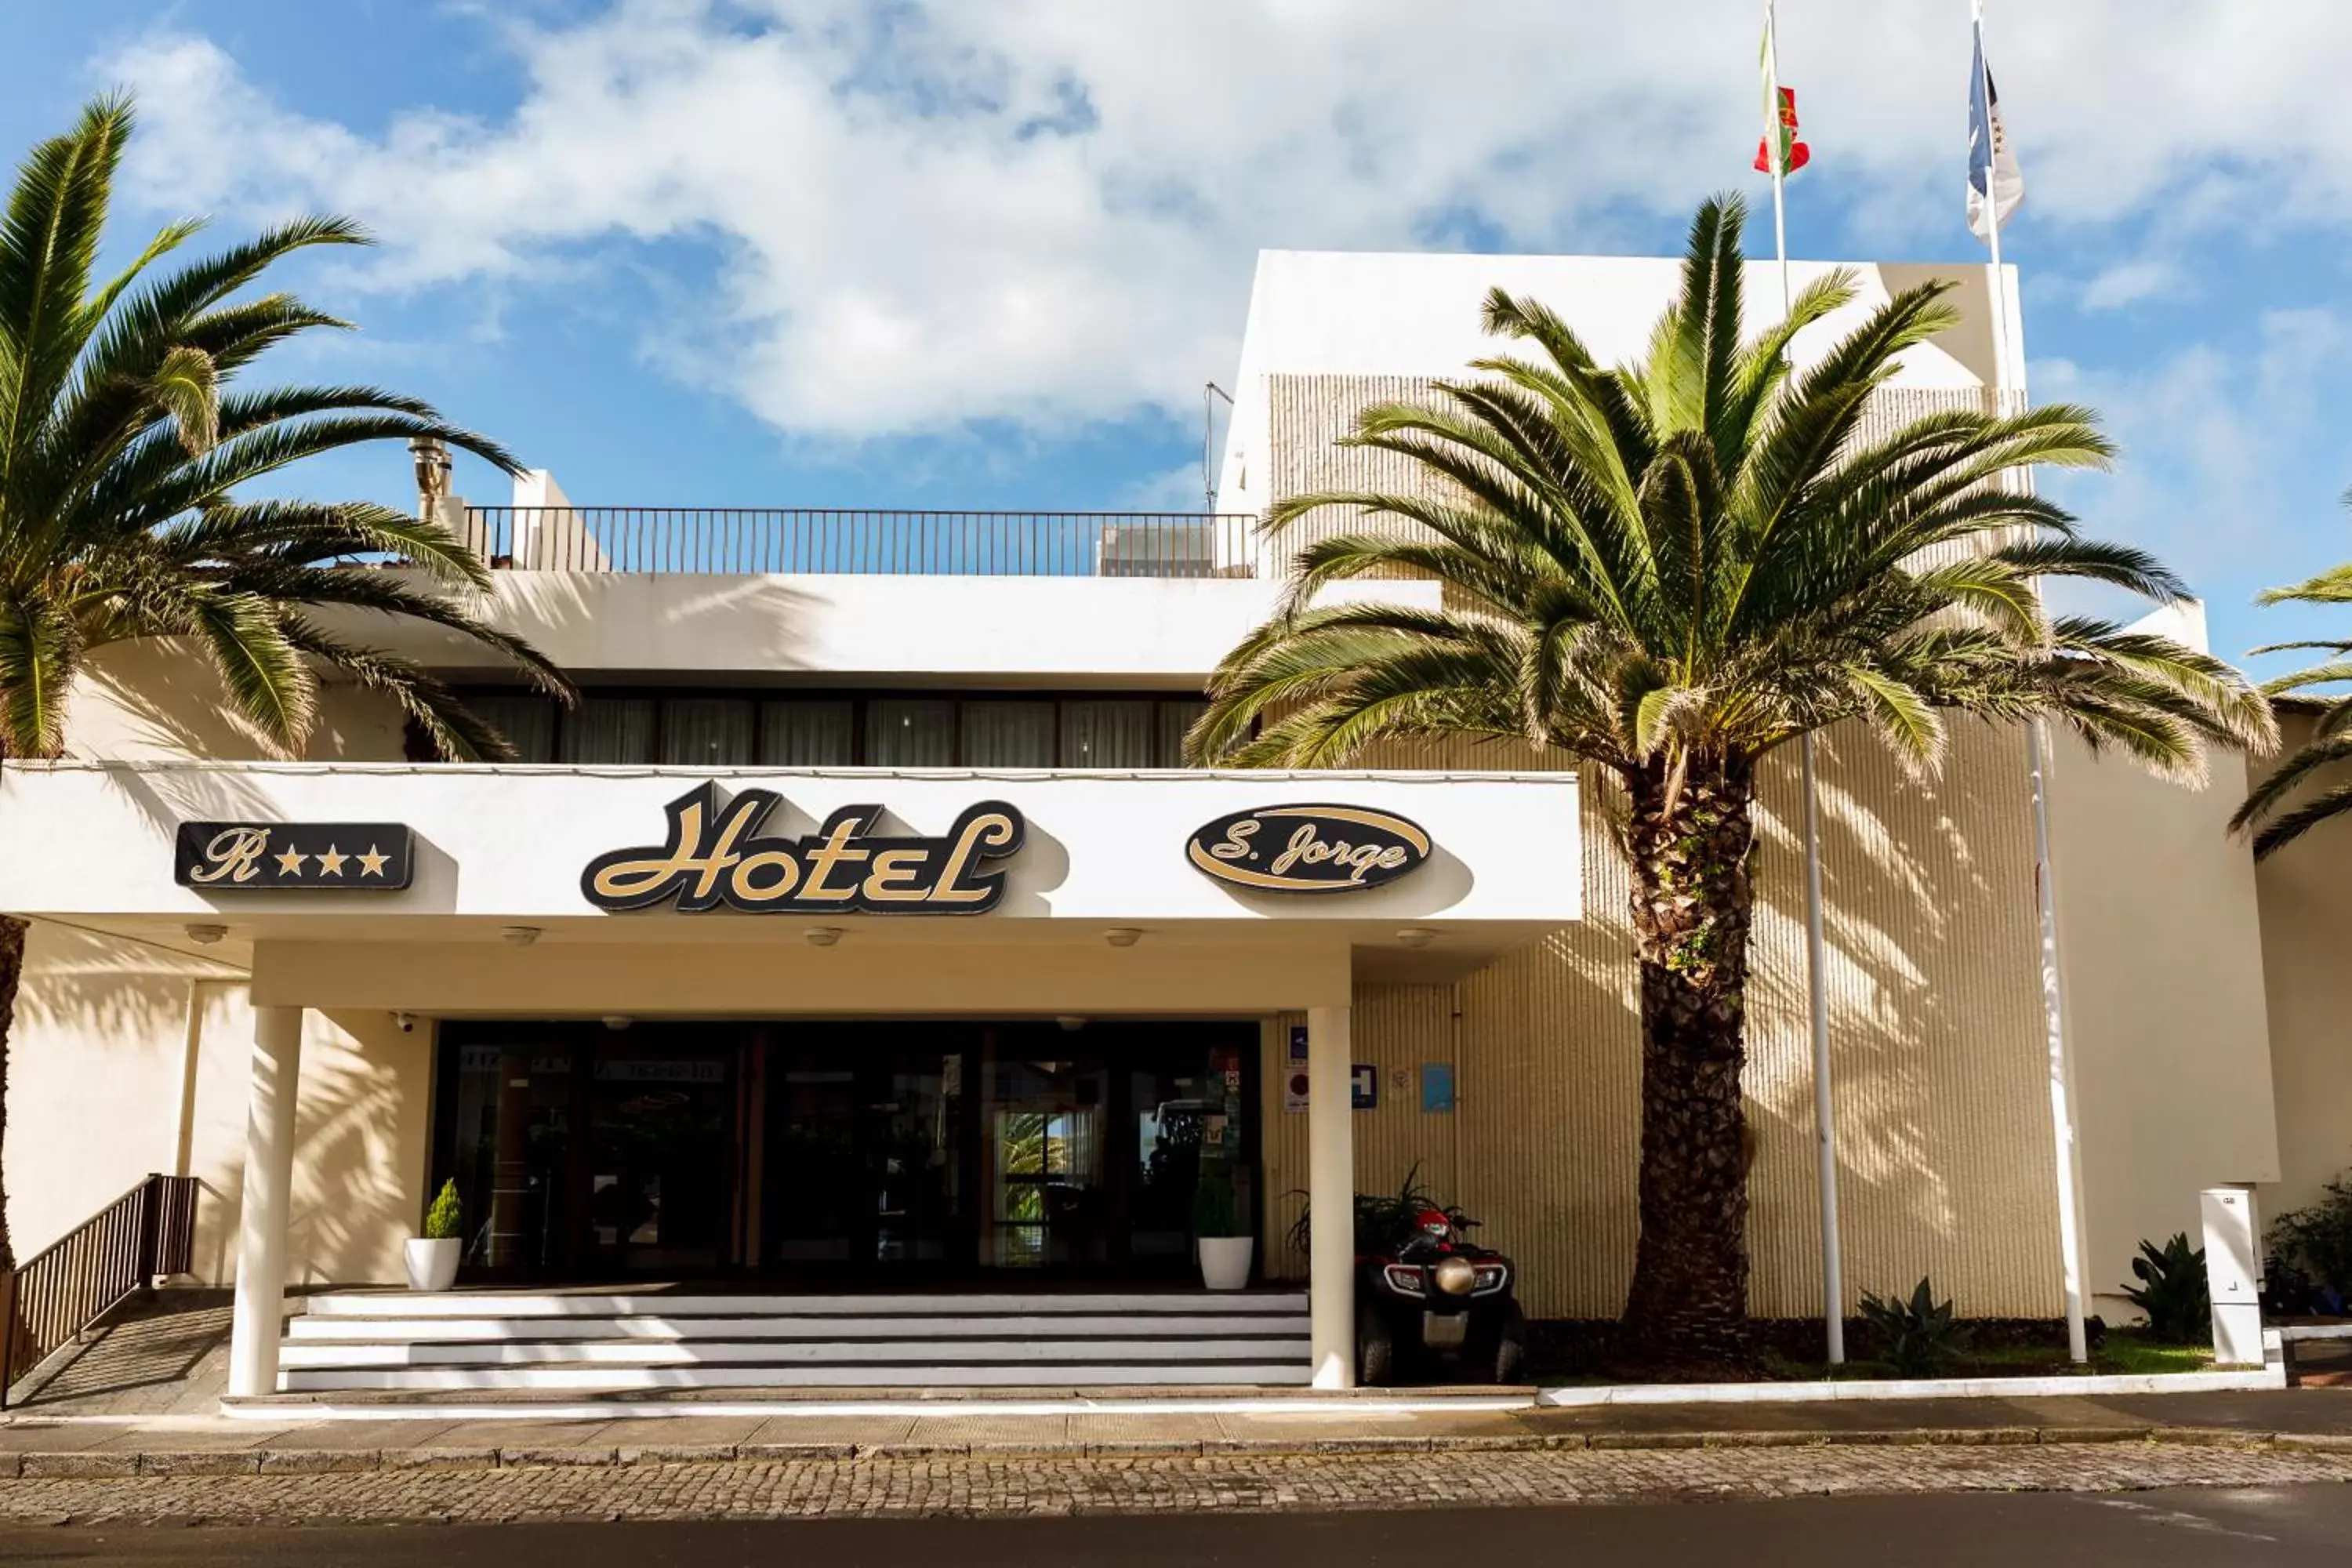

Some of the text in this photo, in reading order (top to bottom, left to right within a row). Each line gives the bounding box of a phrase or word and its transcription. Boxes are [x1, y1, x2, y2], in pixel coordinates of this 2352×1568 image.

[190, 826, 271, 883] R
[1210, 819, 1408, 883] S. Jorge
